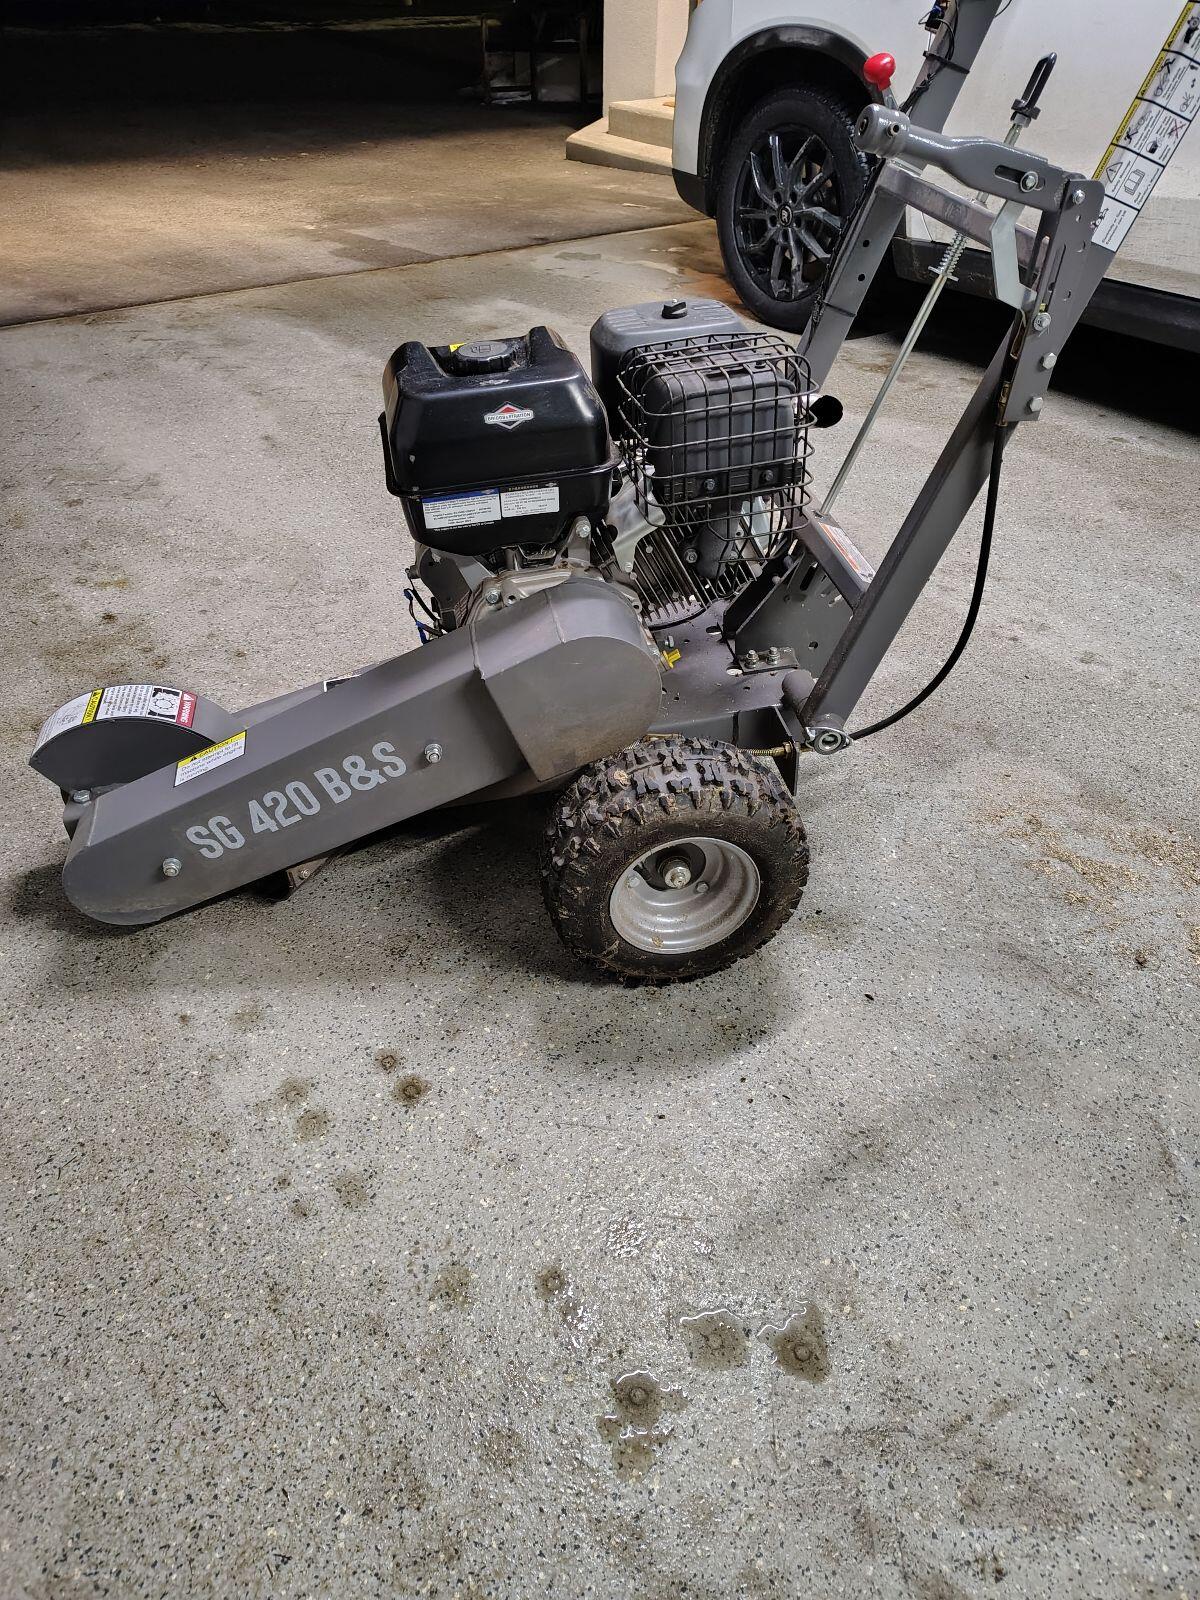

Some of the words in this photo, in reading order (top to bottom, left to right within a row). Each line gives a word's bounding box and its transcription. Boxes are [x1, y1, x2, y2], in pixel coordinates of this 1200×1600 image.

[186, 815, 247, 859] SG
[248, 781, 321, 835] 420
[313, 741, 407, 804] B&S
